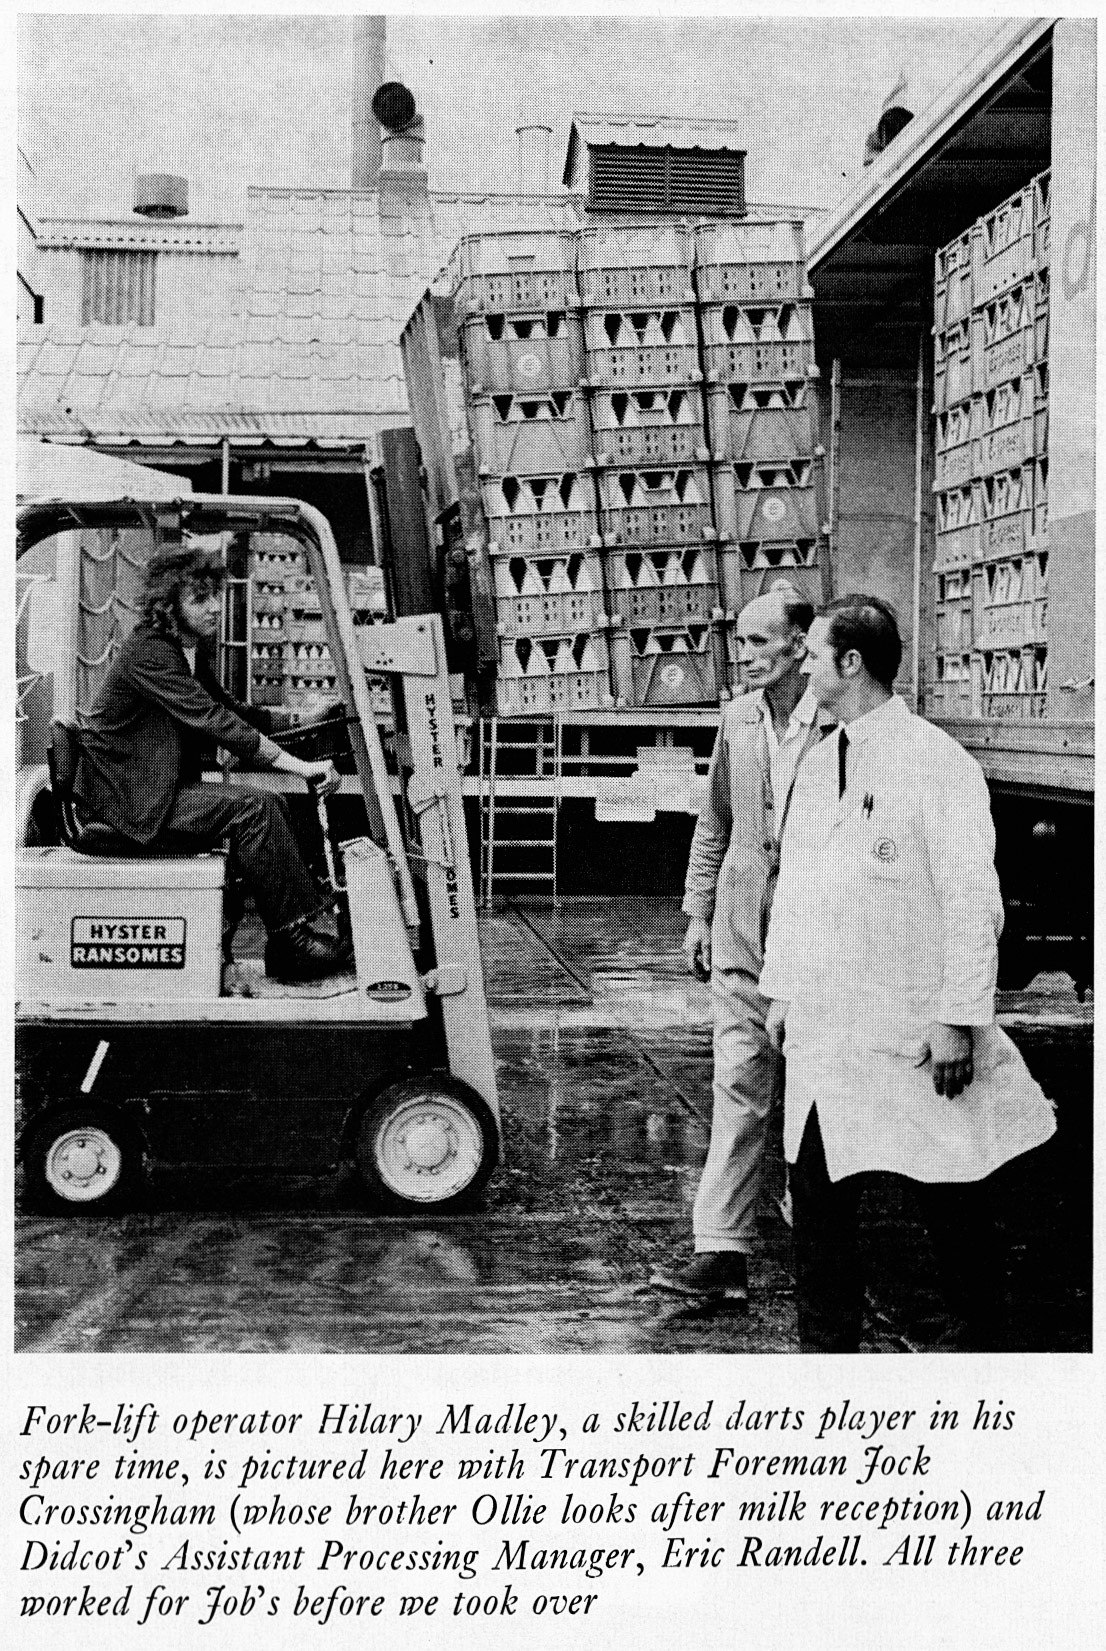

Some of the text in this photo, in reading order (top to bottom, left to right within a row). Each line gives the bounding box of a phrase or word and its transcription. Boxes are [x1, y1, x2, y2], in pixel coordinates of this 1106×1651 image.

[425, 693, 443, 768] HYSTER
[91, 924, 166, 939] HYSTER
[73, 946, 182, 962] RANSOMES
